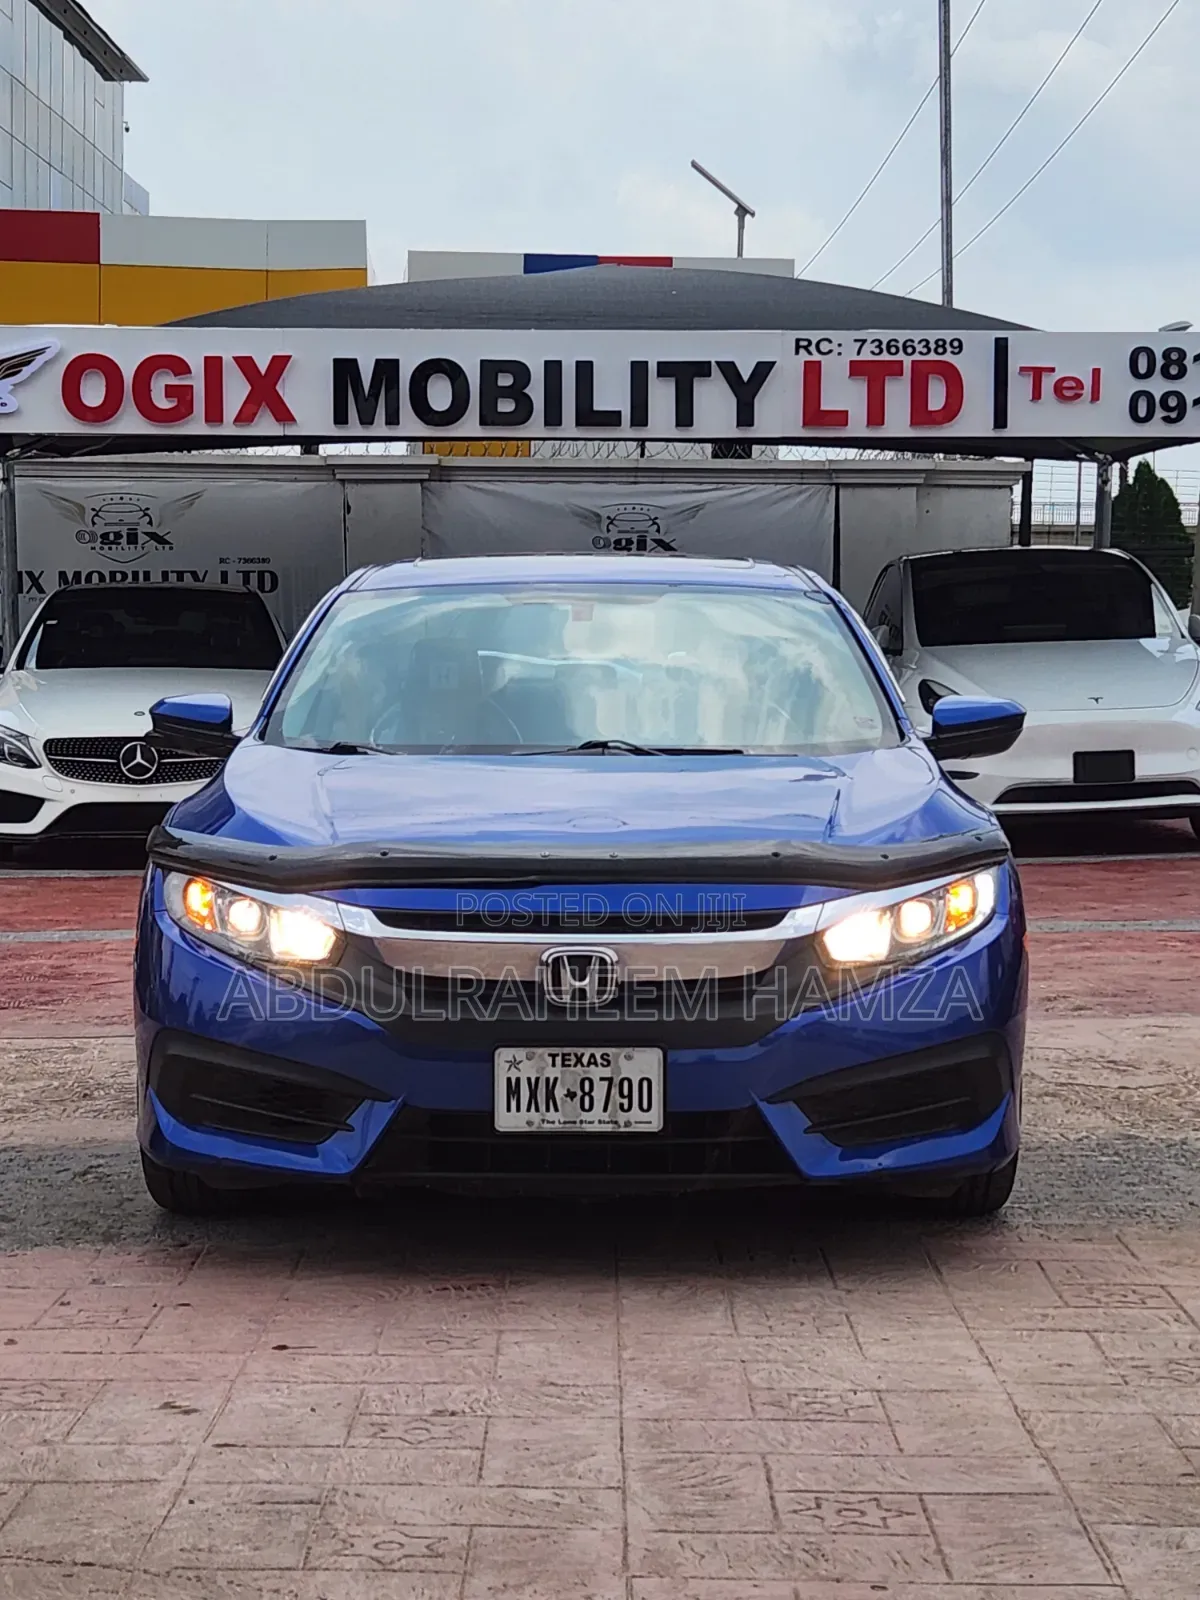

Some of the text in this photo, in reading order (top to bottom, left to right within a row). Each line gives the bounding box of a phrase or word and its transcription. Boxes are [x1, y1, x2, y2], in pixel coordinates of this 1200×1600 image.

[794, 338, 963, 356] RC: 7366389
[61, 353, 1101, 428] OGIX MOBILITY LTD Tel
[219, 557, 231, 565] RC
[17, 570, 47, 595] IX
[548, 1052, 611, 1068] TEXAS
[506, 1076, 653, 1113] MXK 8790
